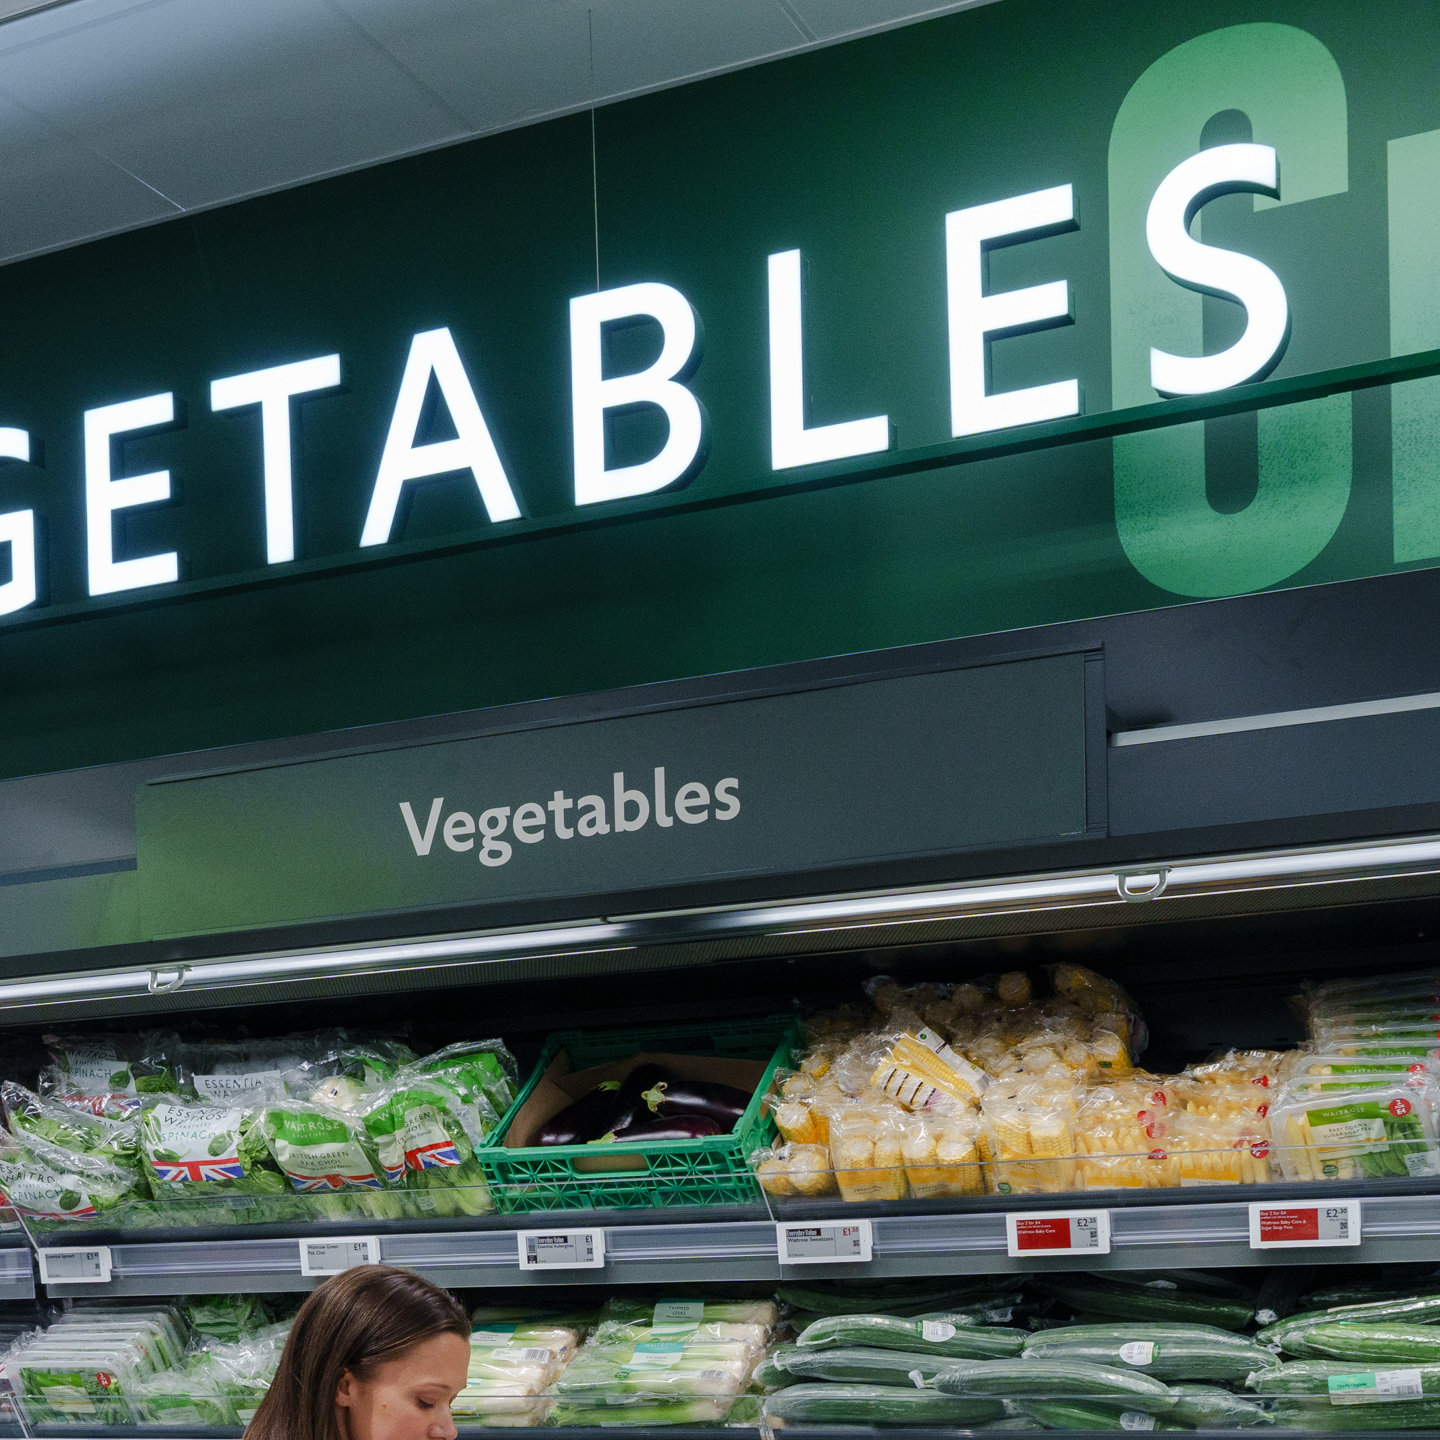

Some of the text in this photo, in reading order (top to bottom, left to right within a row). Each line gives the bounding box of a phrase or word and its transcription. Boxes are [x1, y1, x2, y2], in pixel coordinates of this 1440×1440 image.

[399, 764, 744, 868] Vegetables
[70, 1068, 111, 1078] SPINACH
[205, 1079, 262, 1089] ESSENTIA
[1322, 1107, 1365, 1118] WAITROSE
[161, 1131, 215, 1142] SPINACH
[320, 1151, 349, 1159] GREEN
[12, 1188, 64, 1200] SPINACH
[843, 1227, 859, 1237] £1.55
